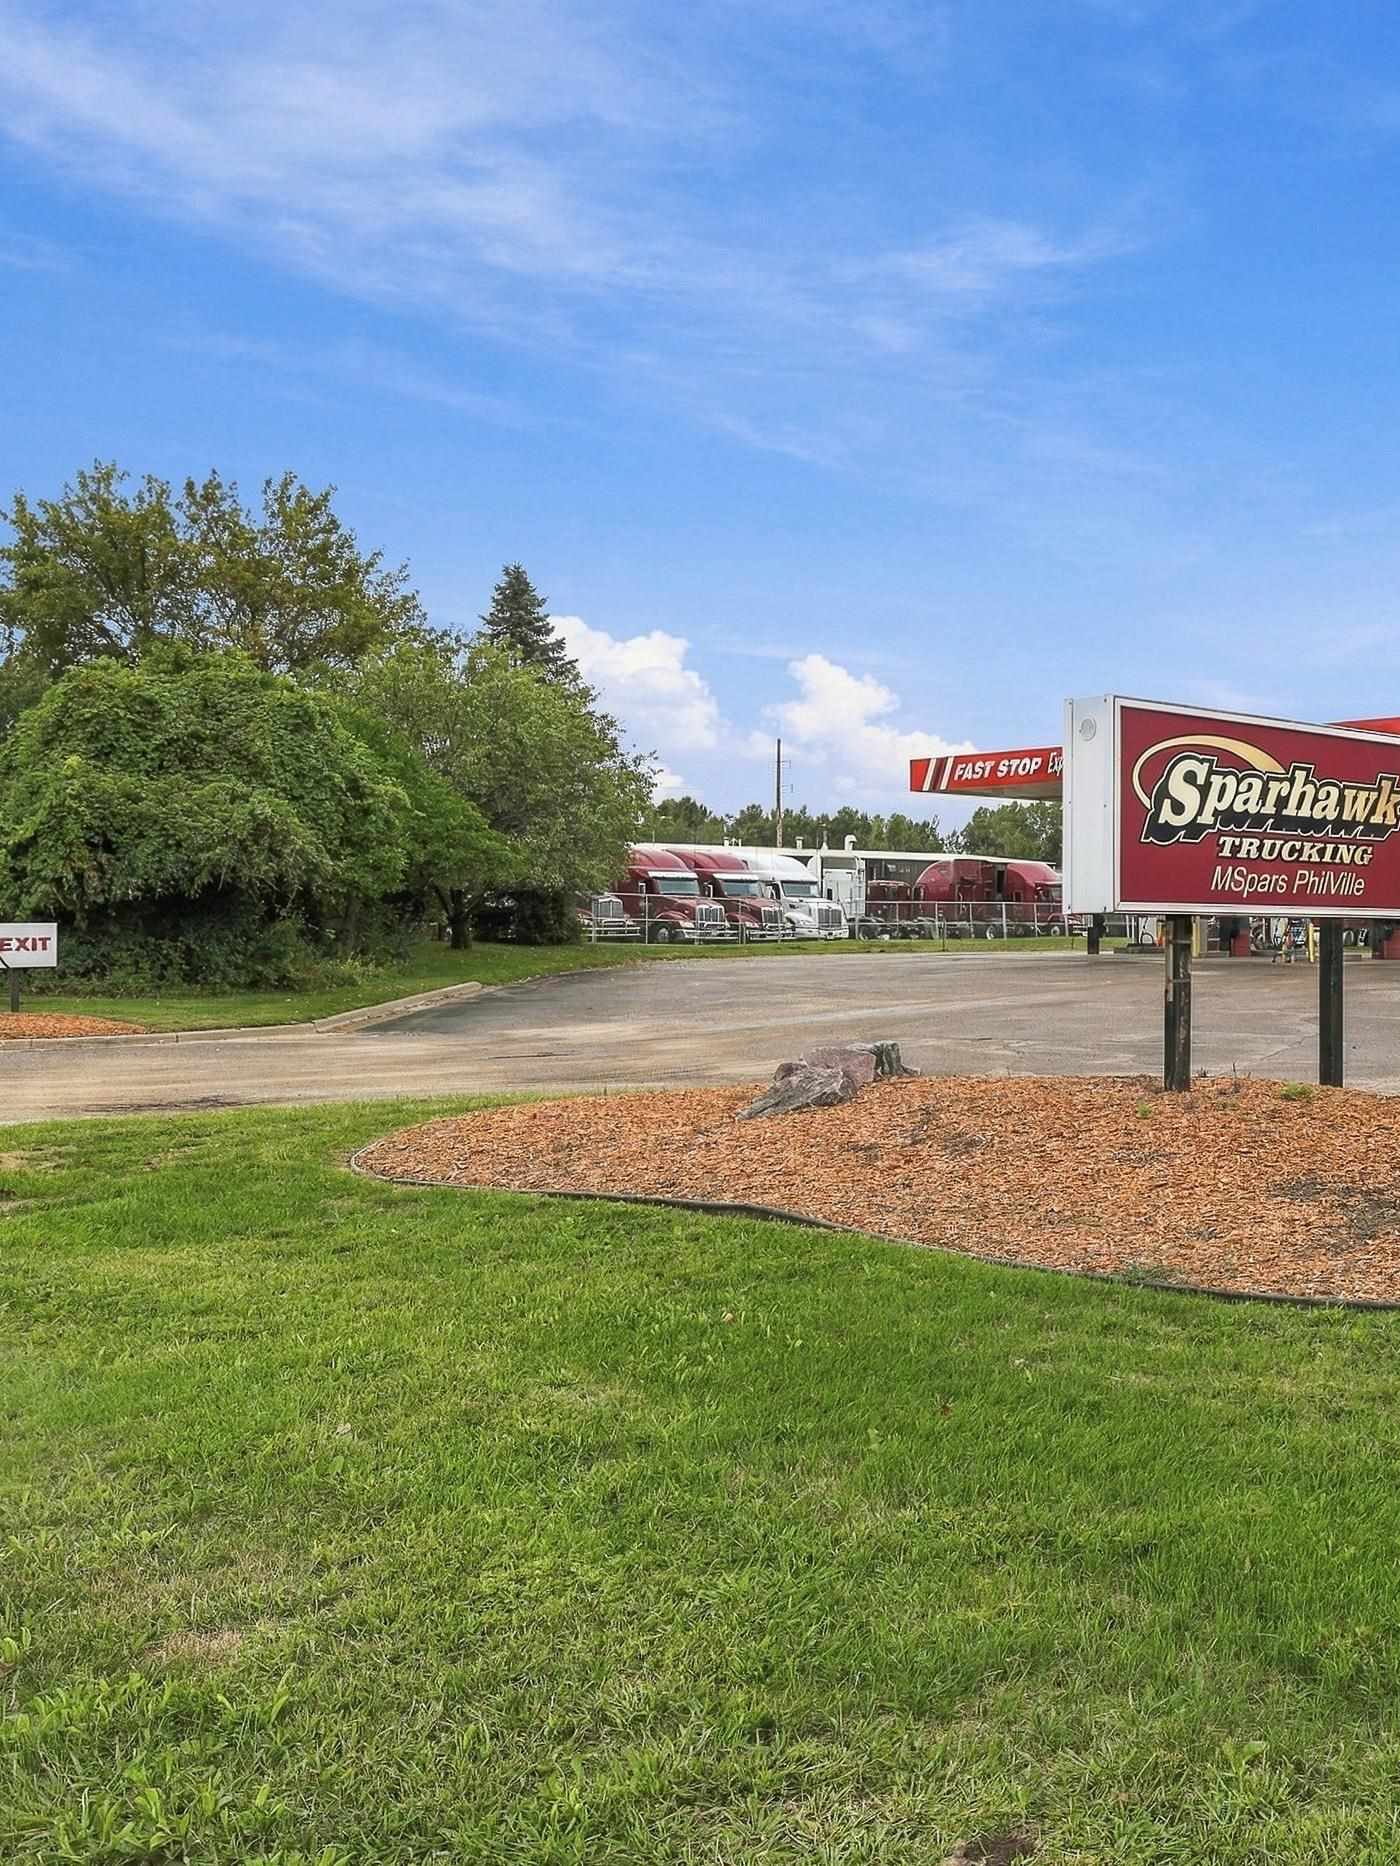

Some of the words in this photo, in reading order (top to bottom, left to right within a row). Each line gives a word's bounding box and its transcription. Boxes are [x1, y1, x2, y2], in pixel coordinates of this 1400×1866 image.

[954, 760, 995, 781] FAST
[997, 757, 1042, 777] STOP
[1218, 836, 1373, 865] TRUCKING
[1210, 865, 1289, 898] MSpars
[1292, 869, 1366, 897] PhilVille
[0, 937, 51, 951] EXIT
